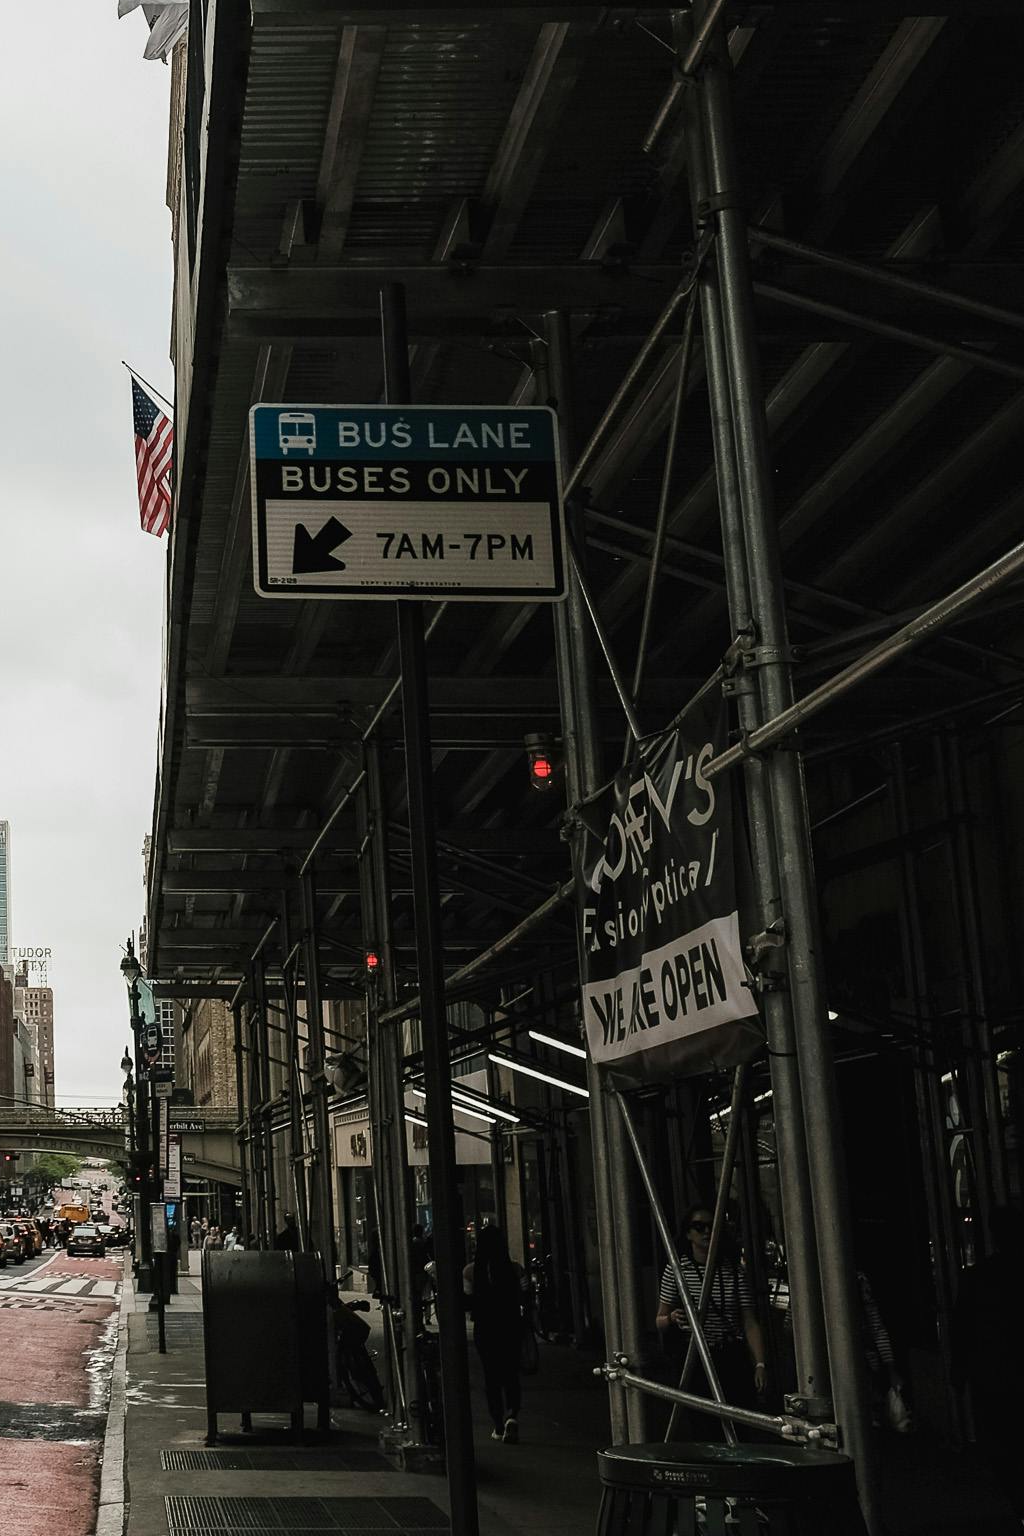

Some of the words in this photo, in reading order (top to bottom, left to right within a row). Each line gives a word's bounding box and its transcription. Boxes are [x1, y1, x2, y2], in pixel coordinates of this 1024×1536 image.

[338, 421, 413, 448] BUS
[429, 422, 531, 449] LANE
[281, 466, 411, 493] BUSES
[428, 468, 529, 494] ONLY
[376, 533, 534, 561] 7AM-7PM
[11, 947, 52, 957] TUDOR
[18, 960, 47, 971] CTY
[590, 987, 626, 1046] WE
[661, 938, 727, 1021] OPEN
